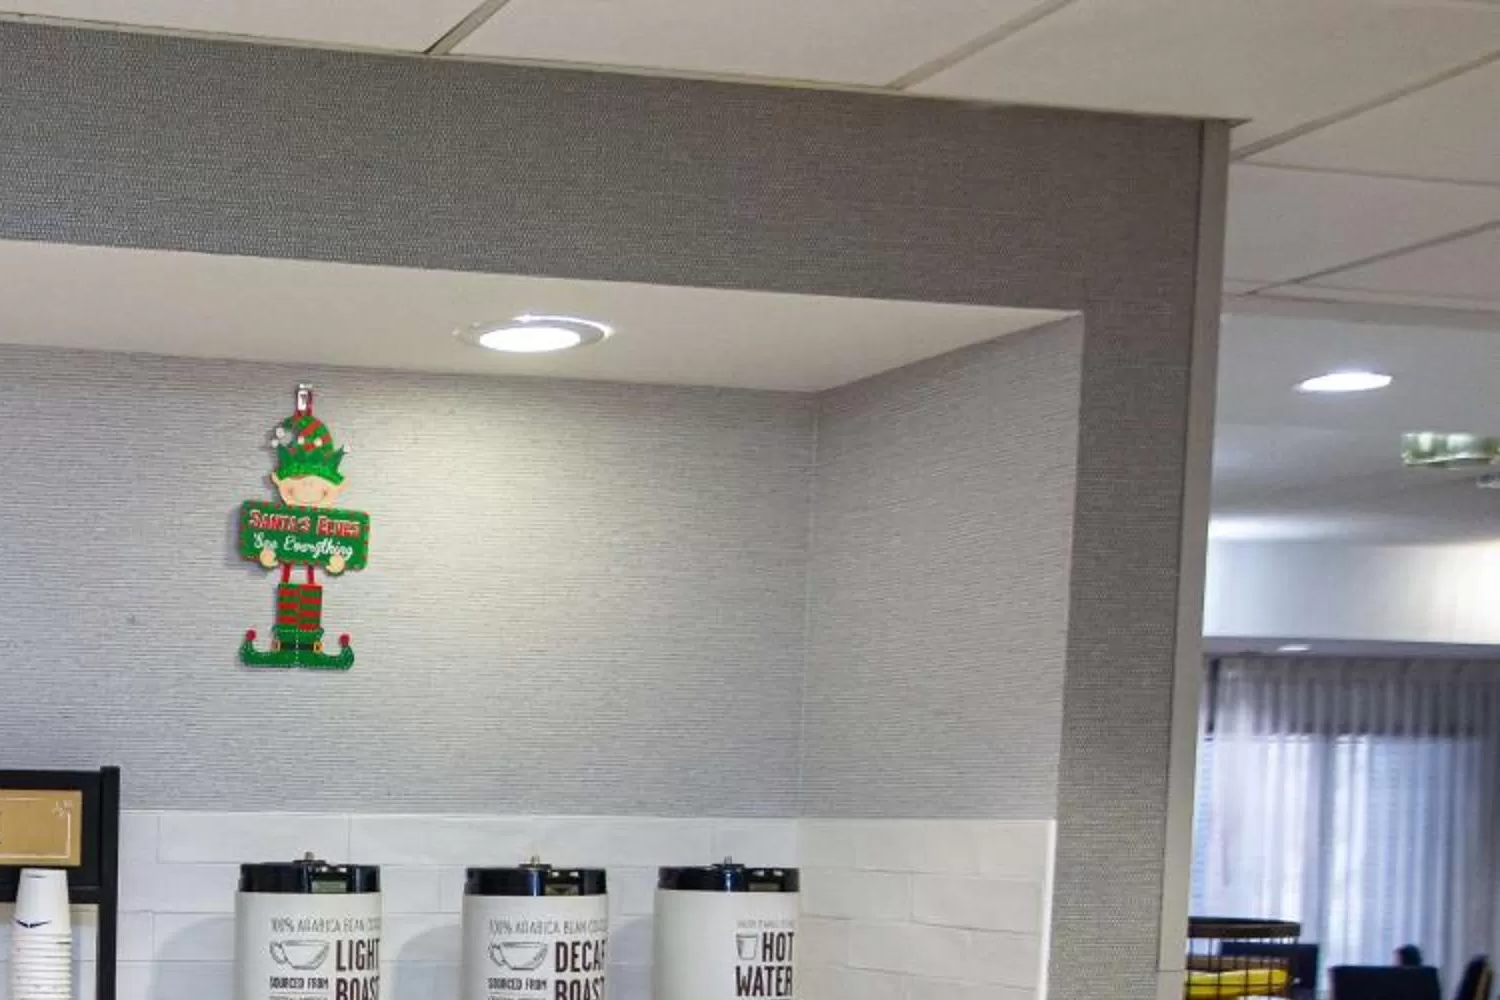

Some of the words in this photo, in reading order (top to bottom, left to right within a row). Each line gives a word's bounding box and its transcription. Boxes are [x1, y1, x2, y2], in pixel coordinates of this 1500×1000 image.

[283, 534, 353, 560] Everything
[515, 919, 560, 935] ARABICA
[762, 931, 795, 962] HOT
[269, 976, 304, 989] SOURCED
[307, 976, 329, 989] FROM
[487, 977, 522, 990] SOURCED
[525, 978, 547, 991] FROM
[735, 965, 794, 997] WATER
